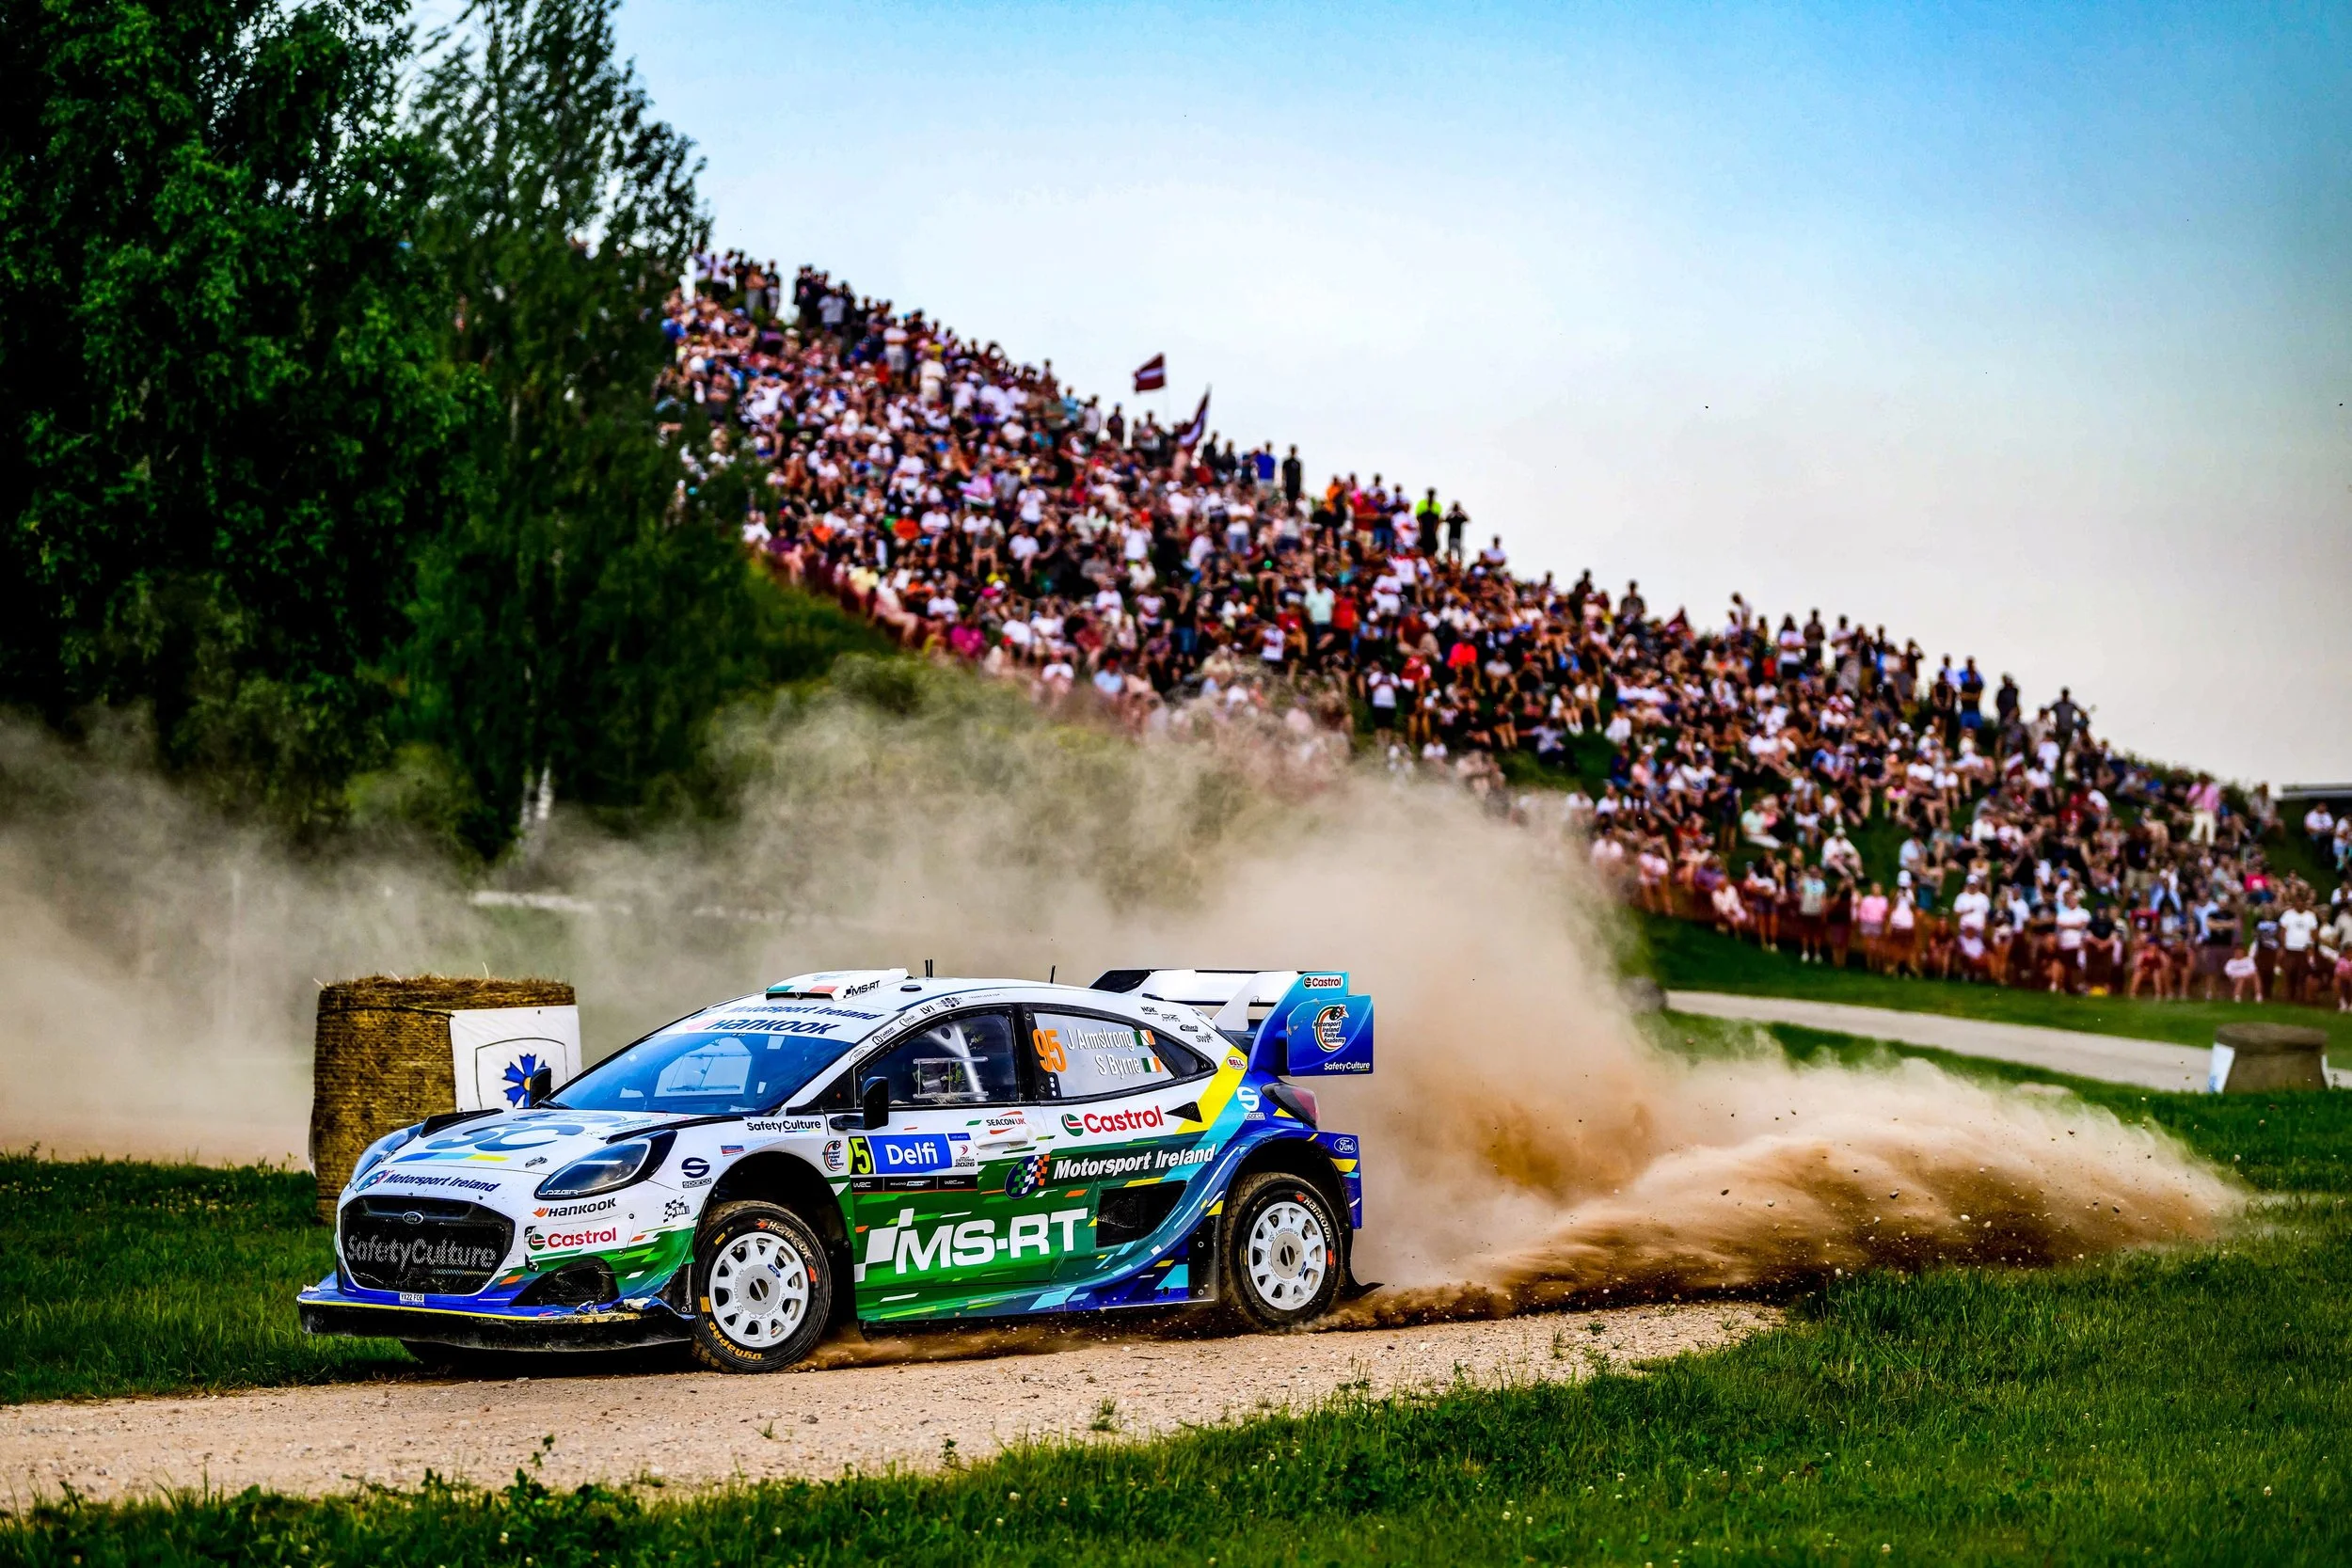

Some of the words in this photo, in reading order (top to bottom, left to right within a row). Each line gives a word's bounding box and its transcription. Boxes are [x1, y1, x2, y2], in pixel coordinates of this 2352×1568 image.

[851, 980, 881, 997] MS-RT
[1312, 977, 1342, 987] Castrol
[814, 1006, 884, 1021] Ireland
[1032, 1029, 1068, 1073] 95
[1067, 1029, 1075, 1051] J
[1076, 1028, 1135, 1052] Armstrong
[1095, 1054, 1106, 1076] S
[1106, 1054, 1141, 1079] Byrne
[1229, 1058, 1245, 1067] BELL
[1324, 1062, 1370, 1072] SafetyCulture
[746, 1119, 821, 1133] SafetyCulture
[1084, 1105, 1164, 1133] Castrol
[848, 1137, 872, 1174] 5
[885, 1142, 939, 1165] Delfi
[1054, 1155, 1151, 1180] Motorsport
[1155, 1144, 1216, 1169] Ireland
[383, 1173, 451, 1187] Motorsport
[448, 1178, 501, 1193] Ireland
[548, 1227, 617, 1248] Castrol
[896, 1208, 1088, 1275] MS-RT
[347, 1234, 497, 1272] SafetyCulture
